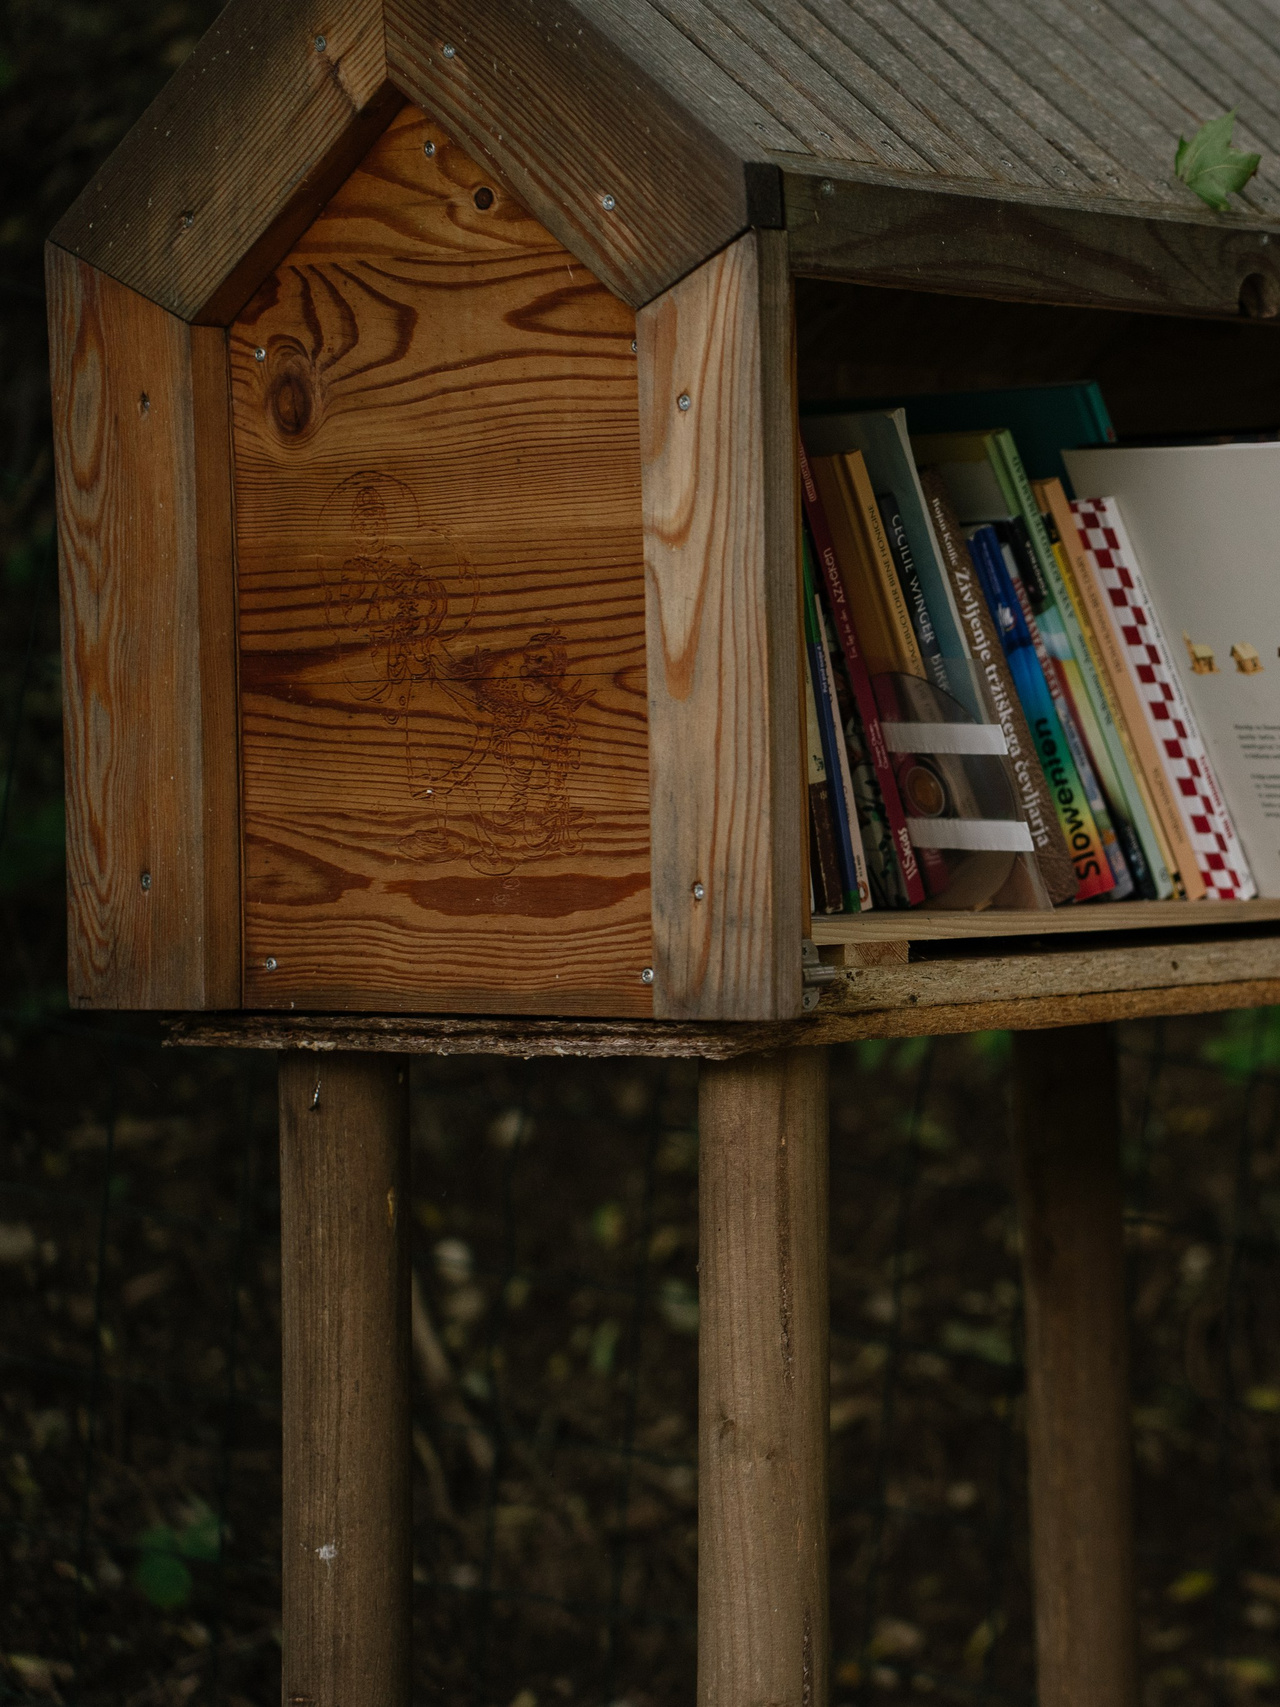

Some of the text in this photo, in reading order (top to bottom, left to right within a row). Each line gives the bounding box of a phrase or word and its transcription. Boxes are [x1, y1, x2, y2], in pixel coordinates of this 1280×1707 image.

[864, 502, 889, 558] HONIGINE
[931, 497, 948, 531] Bojan
[881, 556, 898, 587] BIENE
[889, 586, 904, 608] DER
[891, 514, 916, 573] CECILIE
[908, 577, 936, 643] WINGER
[896, 607, 921, 664] TAGEBUCH
[953, 566, 992, 661] Življenje
[985, 663, 1021, 757] tržiškega
[1013, 758, 1049, 848] čevljarja
[1035, 717, 1100, 880] Slowenien
